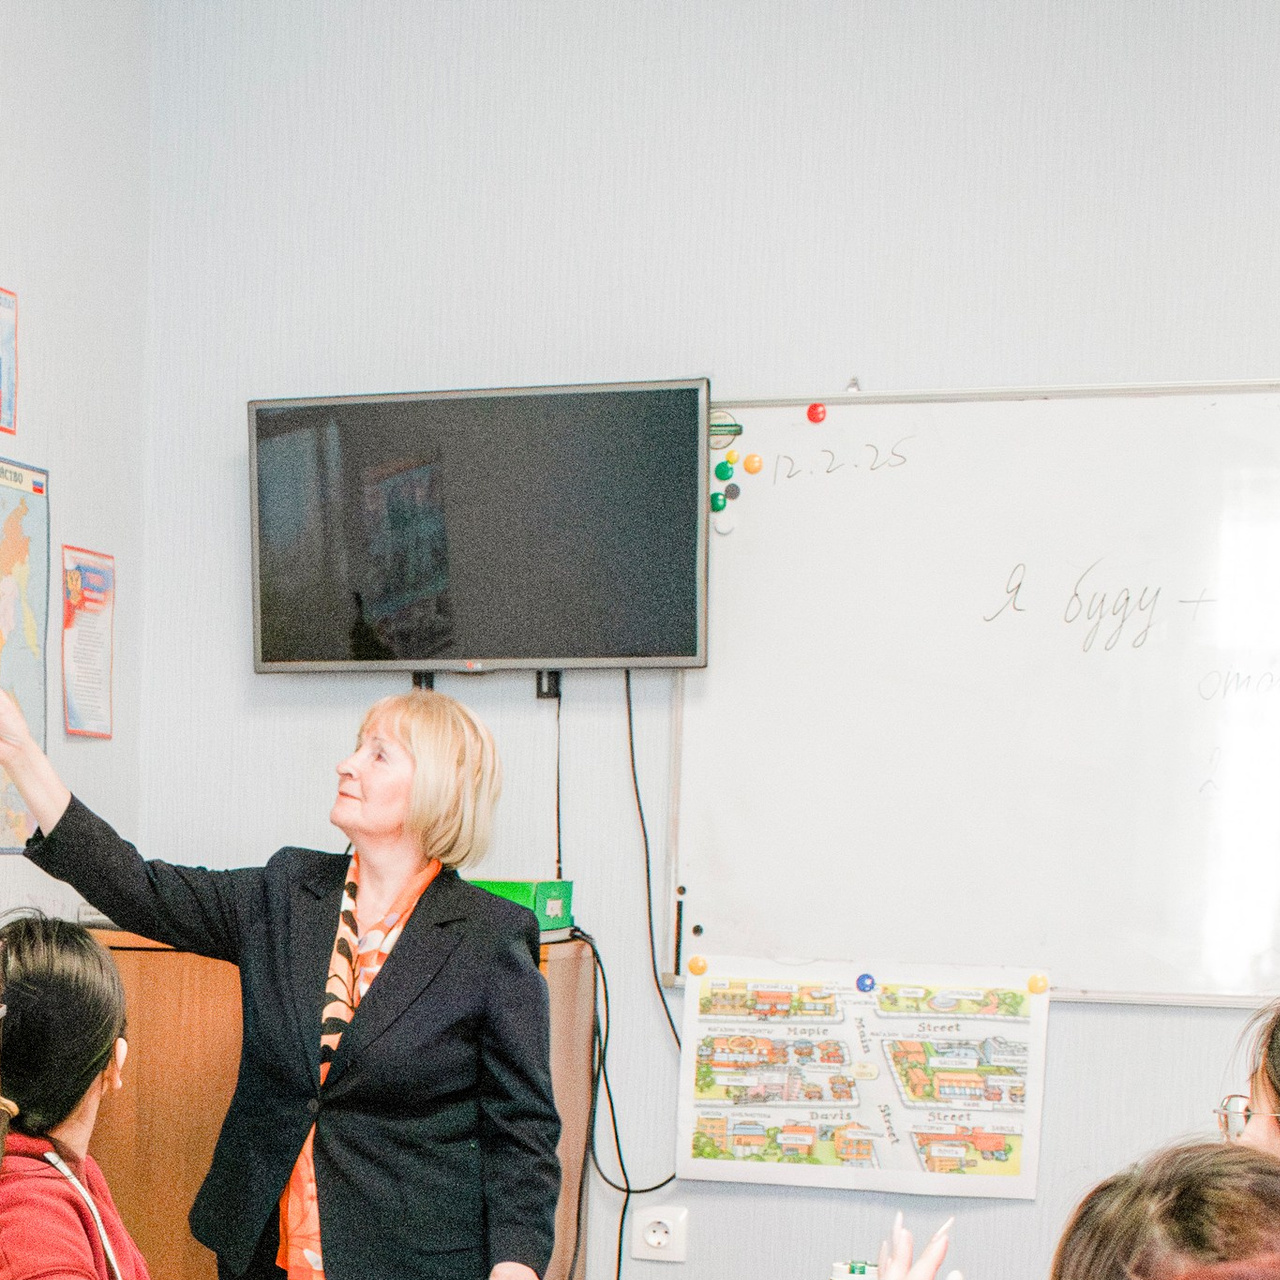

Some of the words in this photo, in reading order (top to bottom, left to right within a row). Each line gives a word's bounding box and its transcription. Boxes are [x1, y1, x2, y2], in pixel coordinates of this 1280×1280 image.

[773, 435, 916, 484] 12.2.25
[984, 563, 1026, 622] Я
[1064, 557, 1162, 652] буду
[787, 1027, 829, 1037] Maple
[918, 1022, 961, 1032] Street
[854, 1016, 871, 1054] Main
[878, 1104, 900, 1146] Street
[810, 1109, 852, 1121] Davis
[928, 1112, 971, 1122] Street
